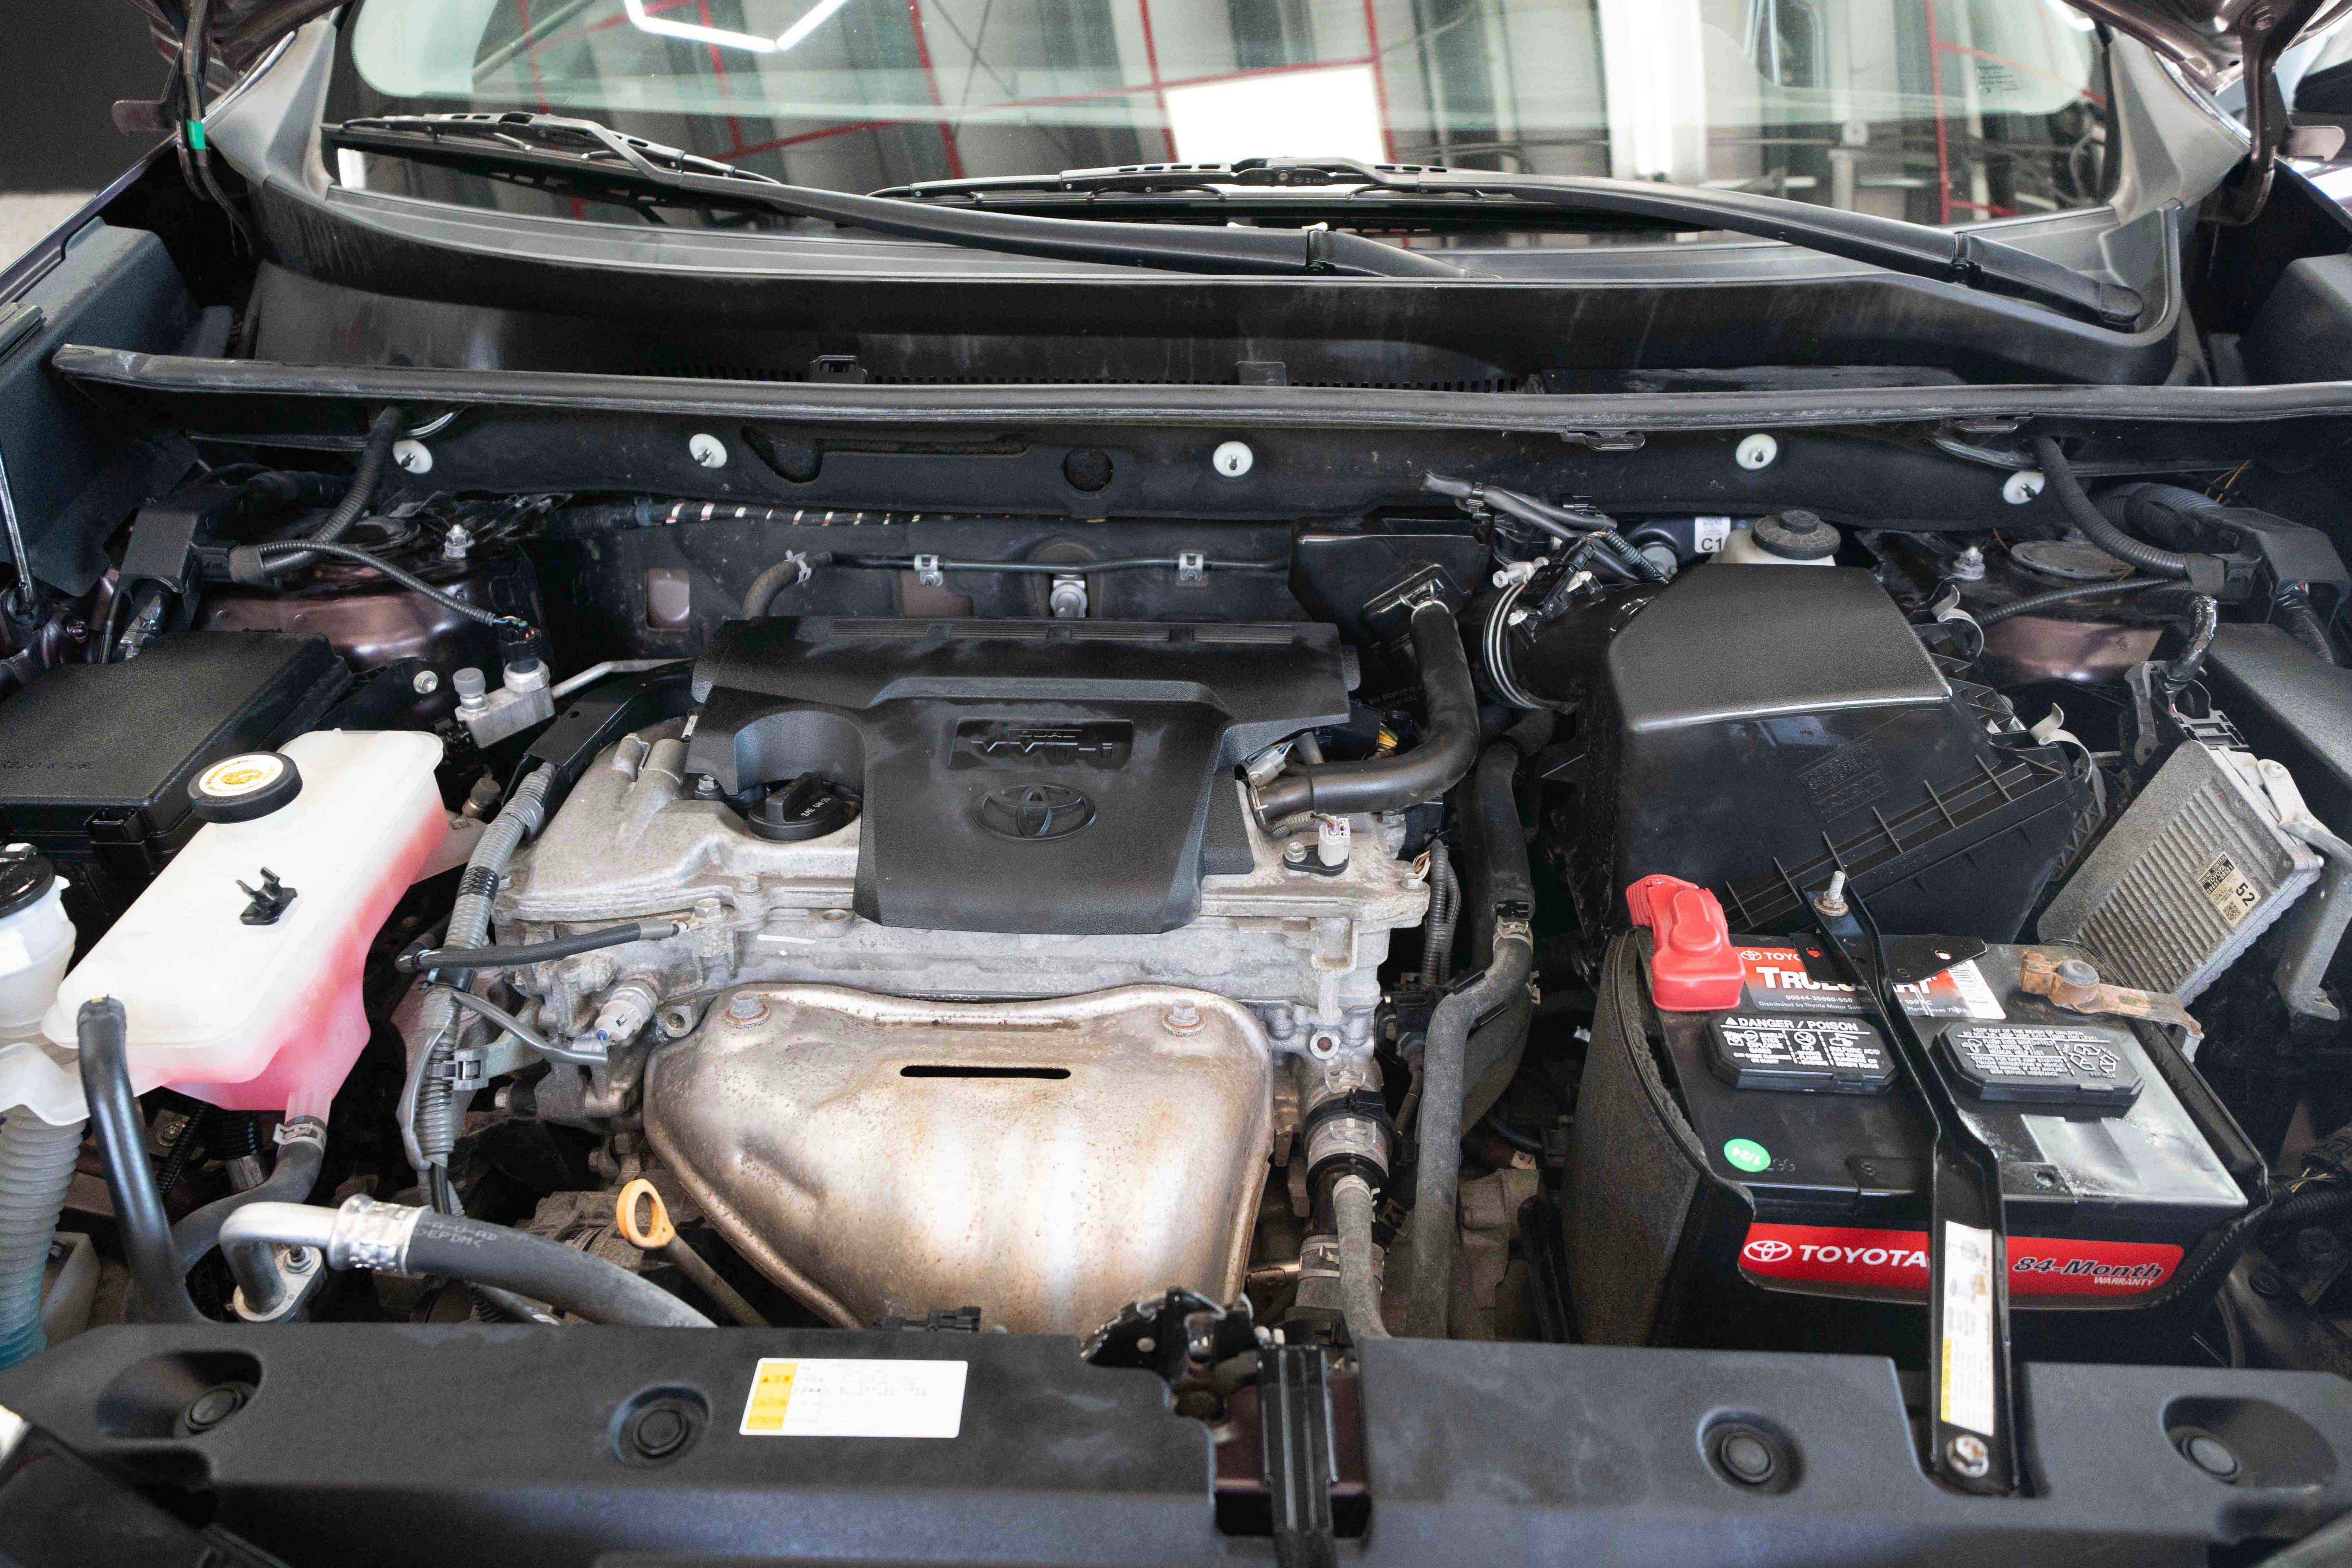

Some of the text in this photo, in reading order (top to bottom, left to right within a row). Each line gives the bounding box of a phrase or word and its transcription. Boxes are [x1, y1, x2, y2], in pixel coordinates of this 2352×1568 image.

[1701, 537, 1722, 551] C1
[800, 797, 831, 816] SAE 0W-20
[2199, 872, 2212, 884] ENGINE
[2212, 855, 2227, 872] CONTROL
[2207, 865, 2227, 884] TOYOTA
[2236, 882, 2255, 906] 52
[1737, 1017, 1794, 1029] DANGER
[1807, 1020, 1859, 1031] POISON
[1731, 1146, 1761, 1166] 1/24
[1799, 1244, 1928, 1268] TOYOTA
[2012, 1256, 2163, 1279] 84-Month
[2094, 1276, 2156, 1287] WARRANTY
